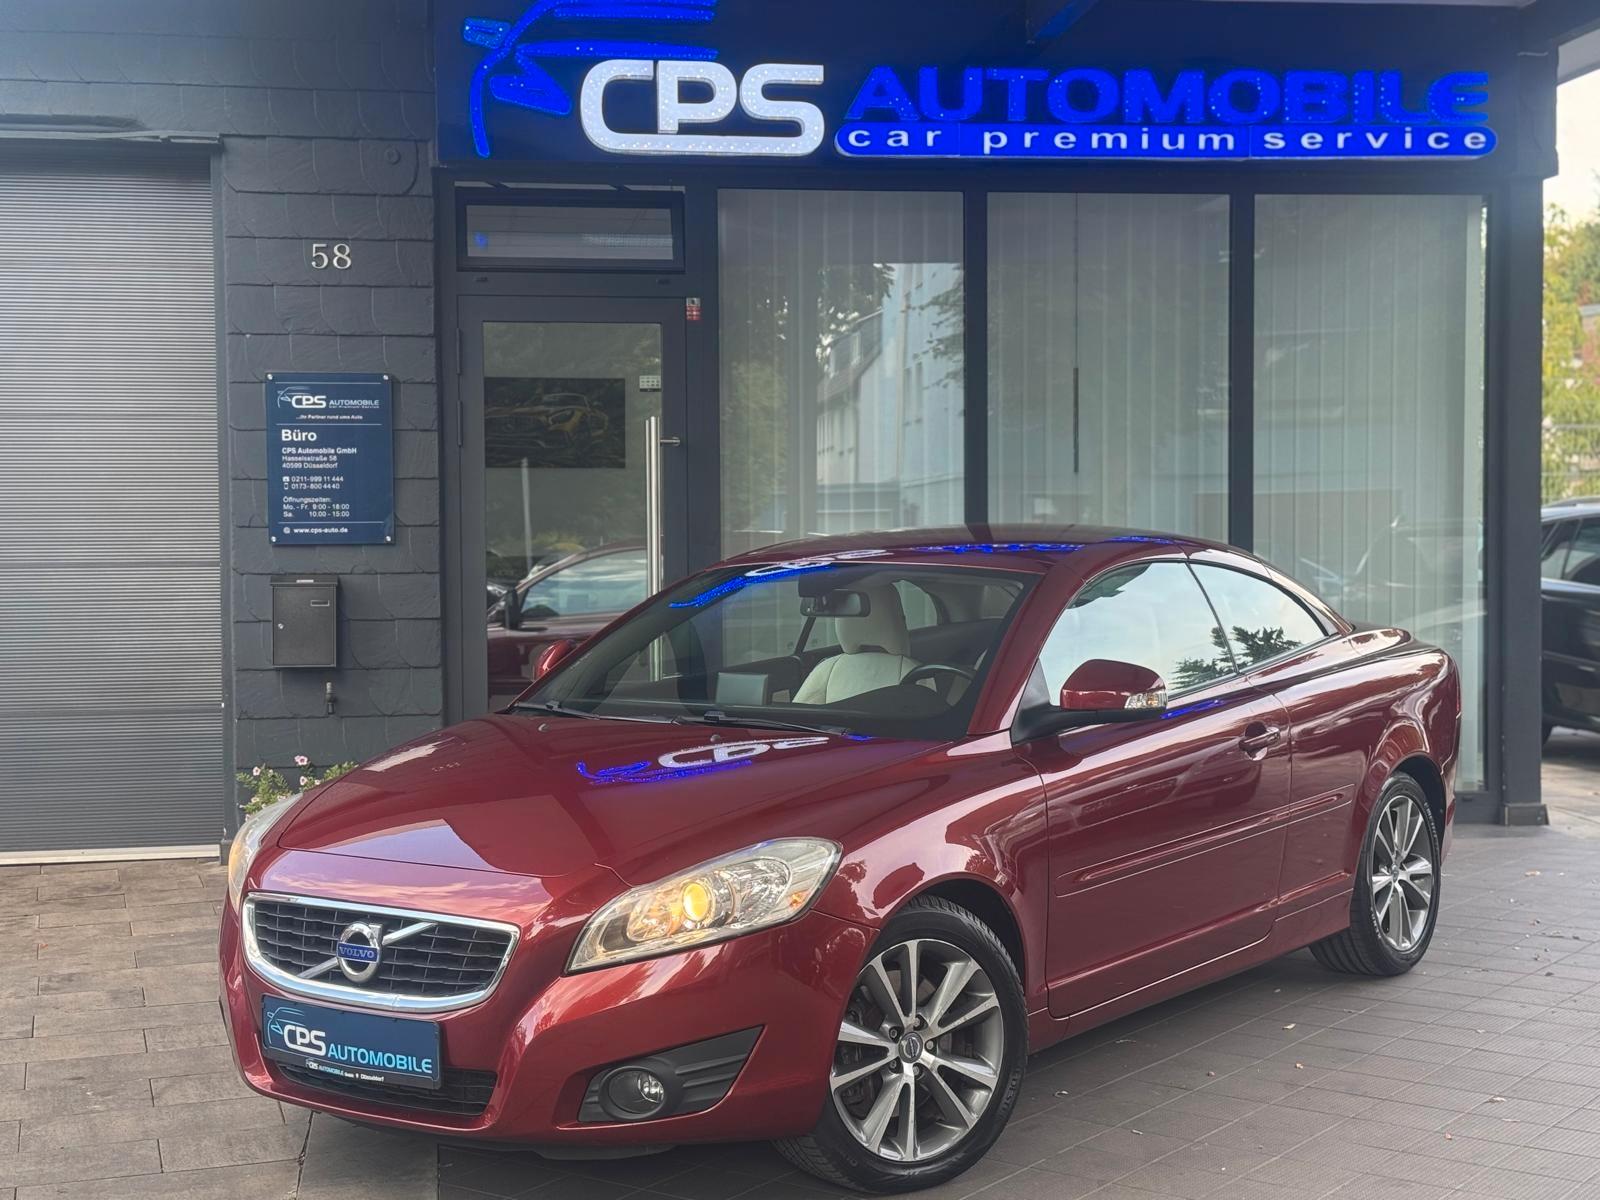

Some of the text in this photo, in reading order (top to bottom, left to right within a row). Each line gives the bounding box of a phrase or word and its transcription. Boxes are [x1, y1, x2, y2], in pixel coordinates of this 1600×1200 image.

[580, 58, 825, 156] CPS
[844, 65, 1489, 123] AUTOMOBILE
[848, 126, 1487, 154] car premium service
[311, 243, 352, 269] 58
[291, 395, 327, 409] CPS
[281, 428, 317, 441] Büro
[339, 946, 375, 959] VOLVO
[283, 1024, 433, 1074] CPS AUTOMOBILE
